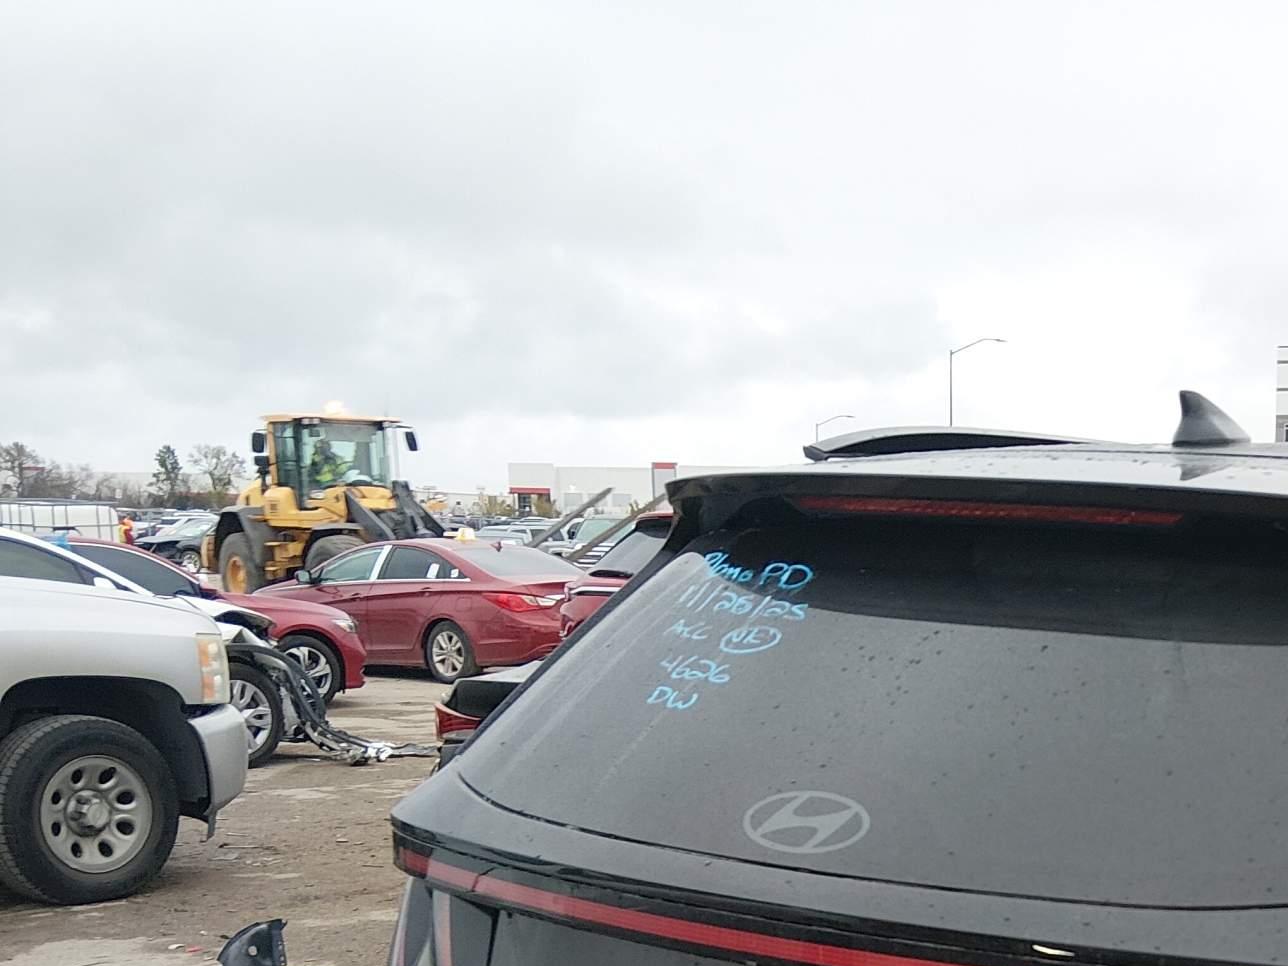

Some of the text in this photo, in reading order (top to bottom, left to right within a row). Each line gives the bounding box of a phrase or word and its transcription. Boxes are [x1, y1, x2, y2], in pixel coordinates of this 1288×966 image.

[759, 562, 813, 590] PD
[660, 655, 730, 683] 4626
[646, 685, 699, 709] DW
